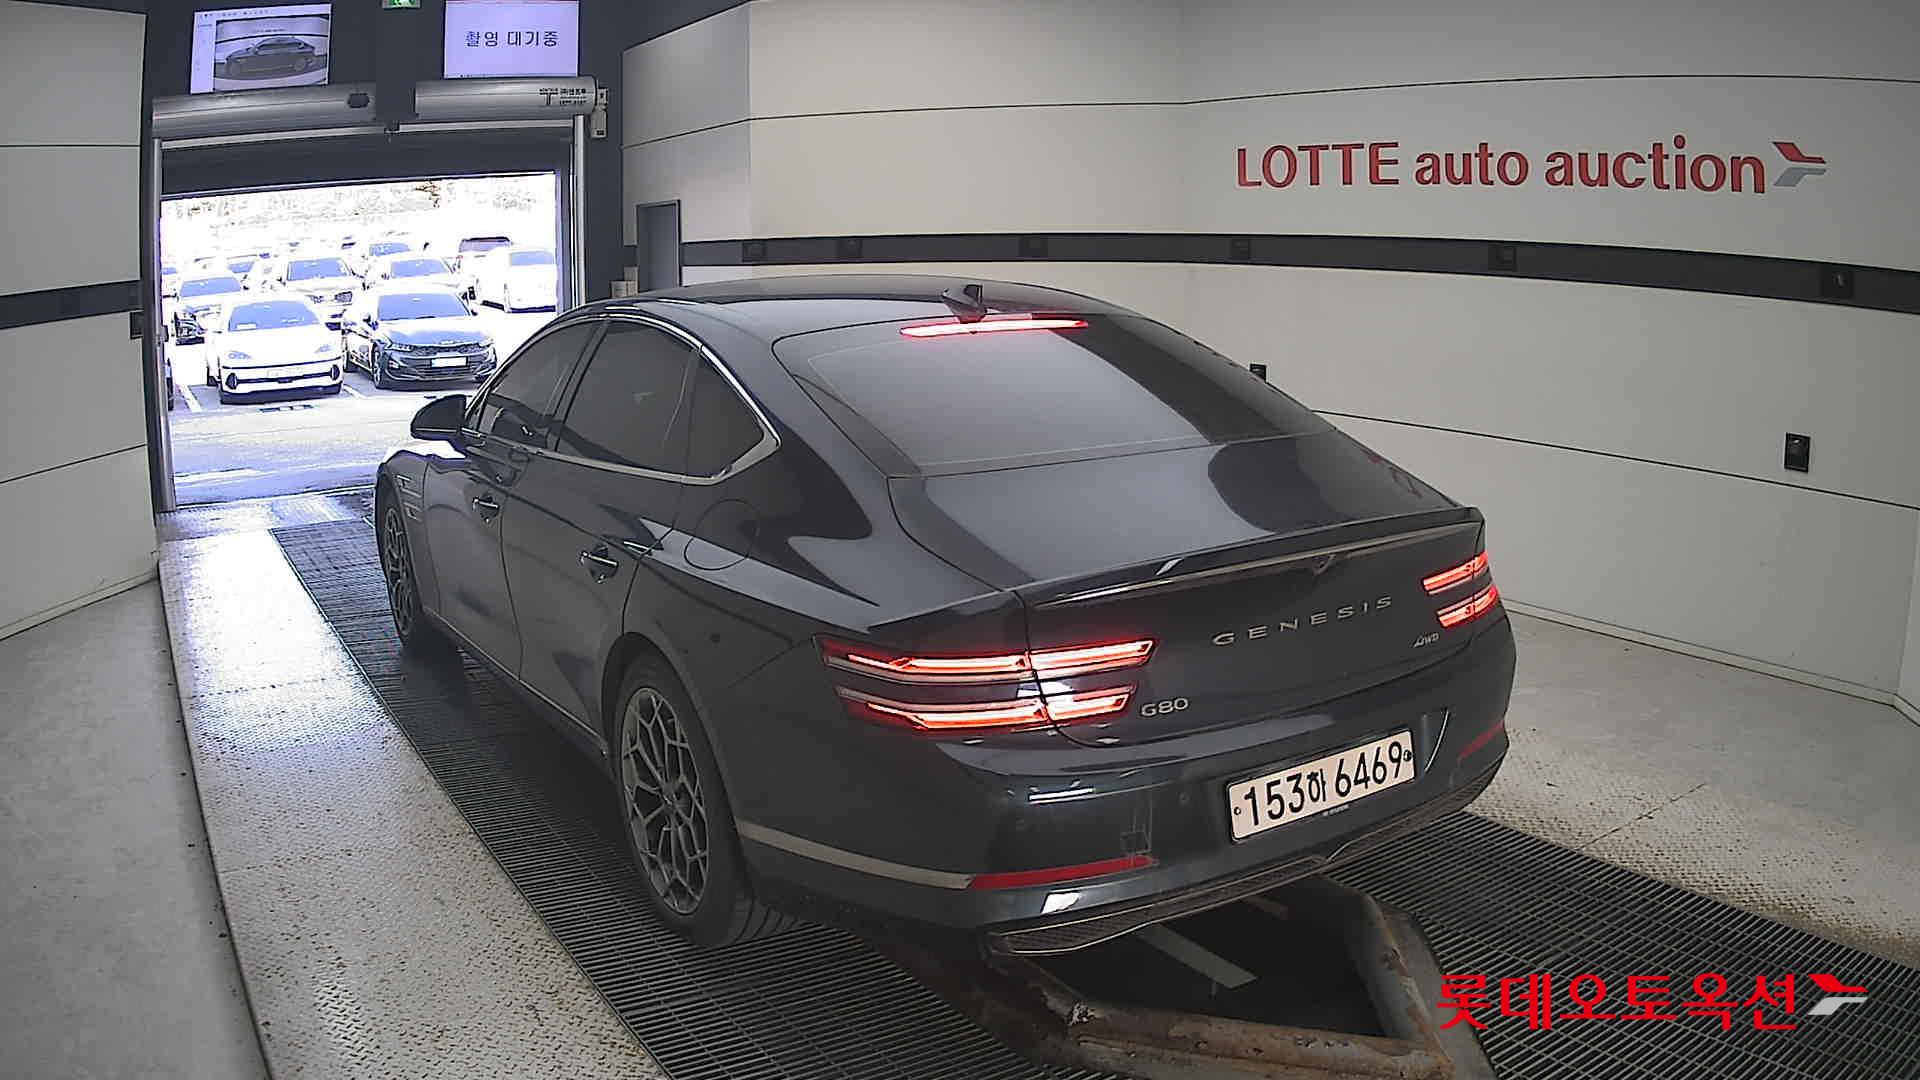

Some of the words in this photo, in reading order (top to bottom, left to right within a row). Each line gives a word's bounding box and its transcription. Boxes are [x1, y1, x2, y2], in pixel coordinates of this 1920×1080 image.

[507, 31, 559, 48] 대기중
[1237, 141, 1400, 190] LOTTE
[1415, 142, 1529, 187] auto
[1543, 134, 1766, 194] auction
[1212, 595, 1394, 646] GENESIS
[1140, 697, 1190, 717] G80
